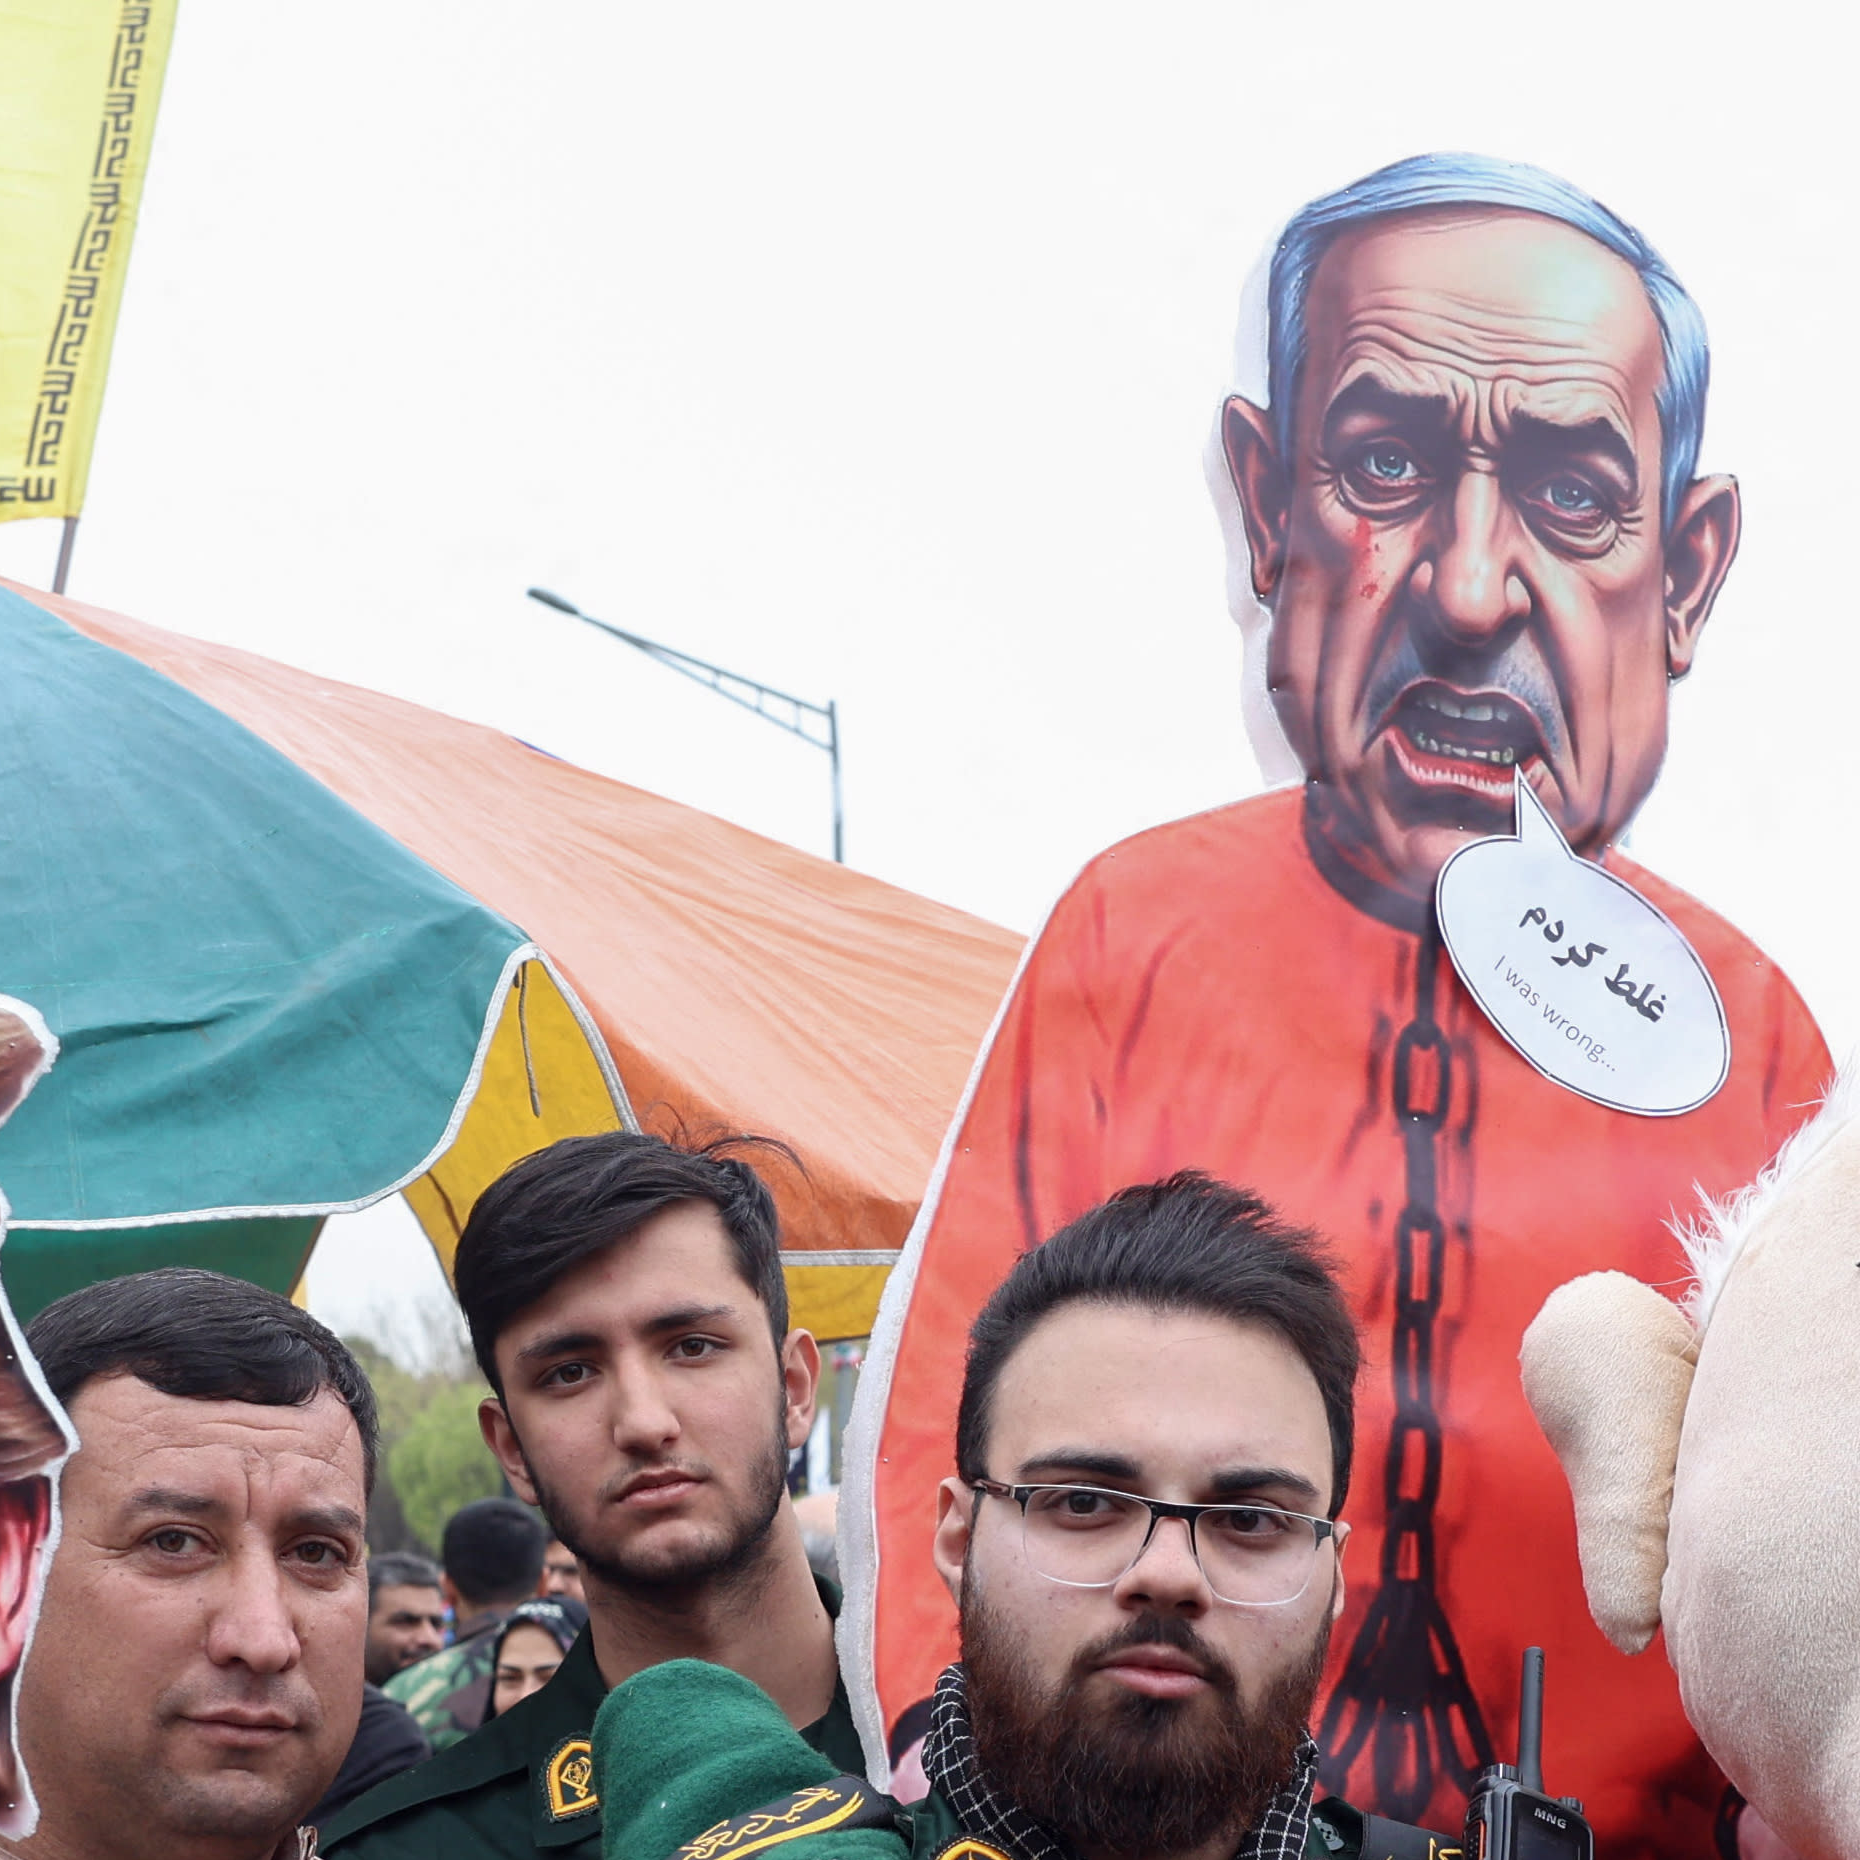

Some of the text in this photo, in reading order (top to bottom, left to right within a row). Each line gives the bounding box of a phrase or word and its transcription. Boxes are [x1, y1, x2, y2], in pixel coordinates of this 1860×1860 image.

[1493, 955, 1617, 1072] I was wrong...
[1518, 905, 1668, 1024] غلط کردم
[1533, 1806, 1568, 1830] MNG
